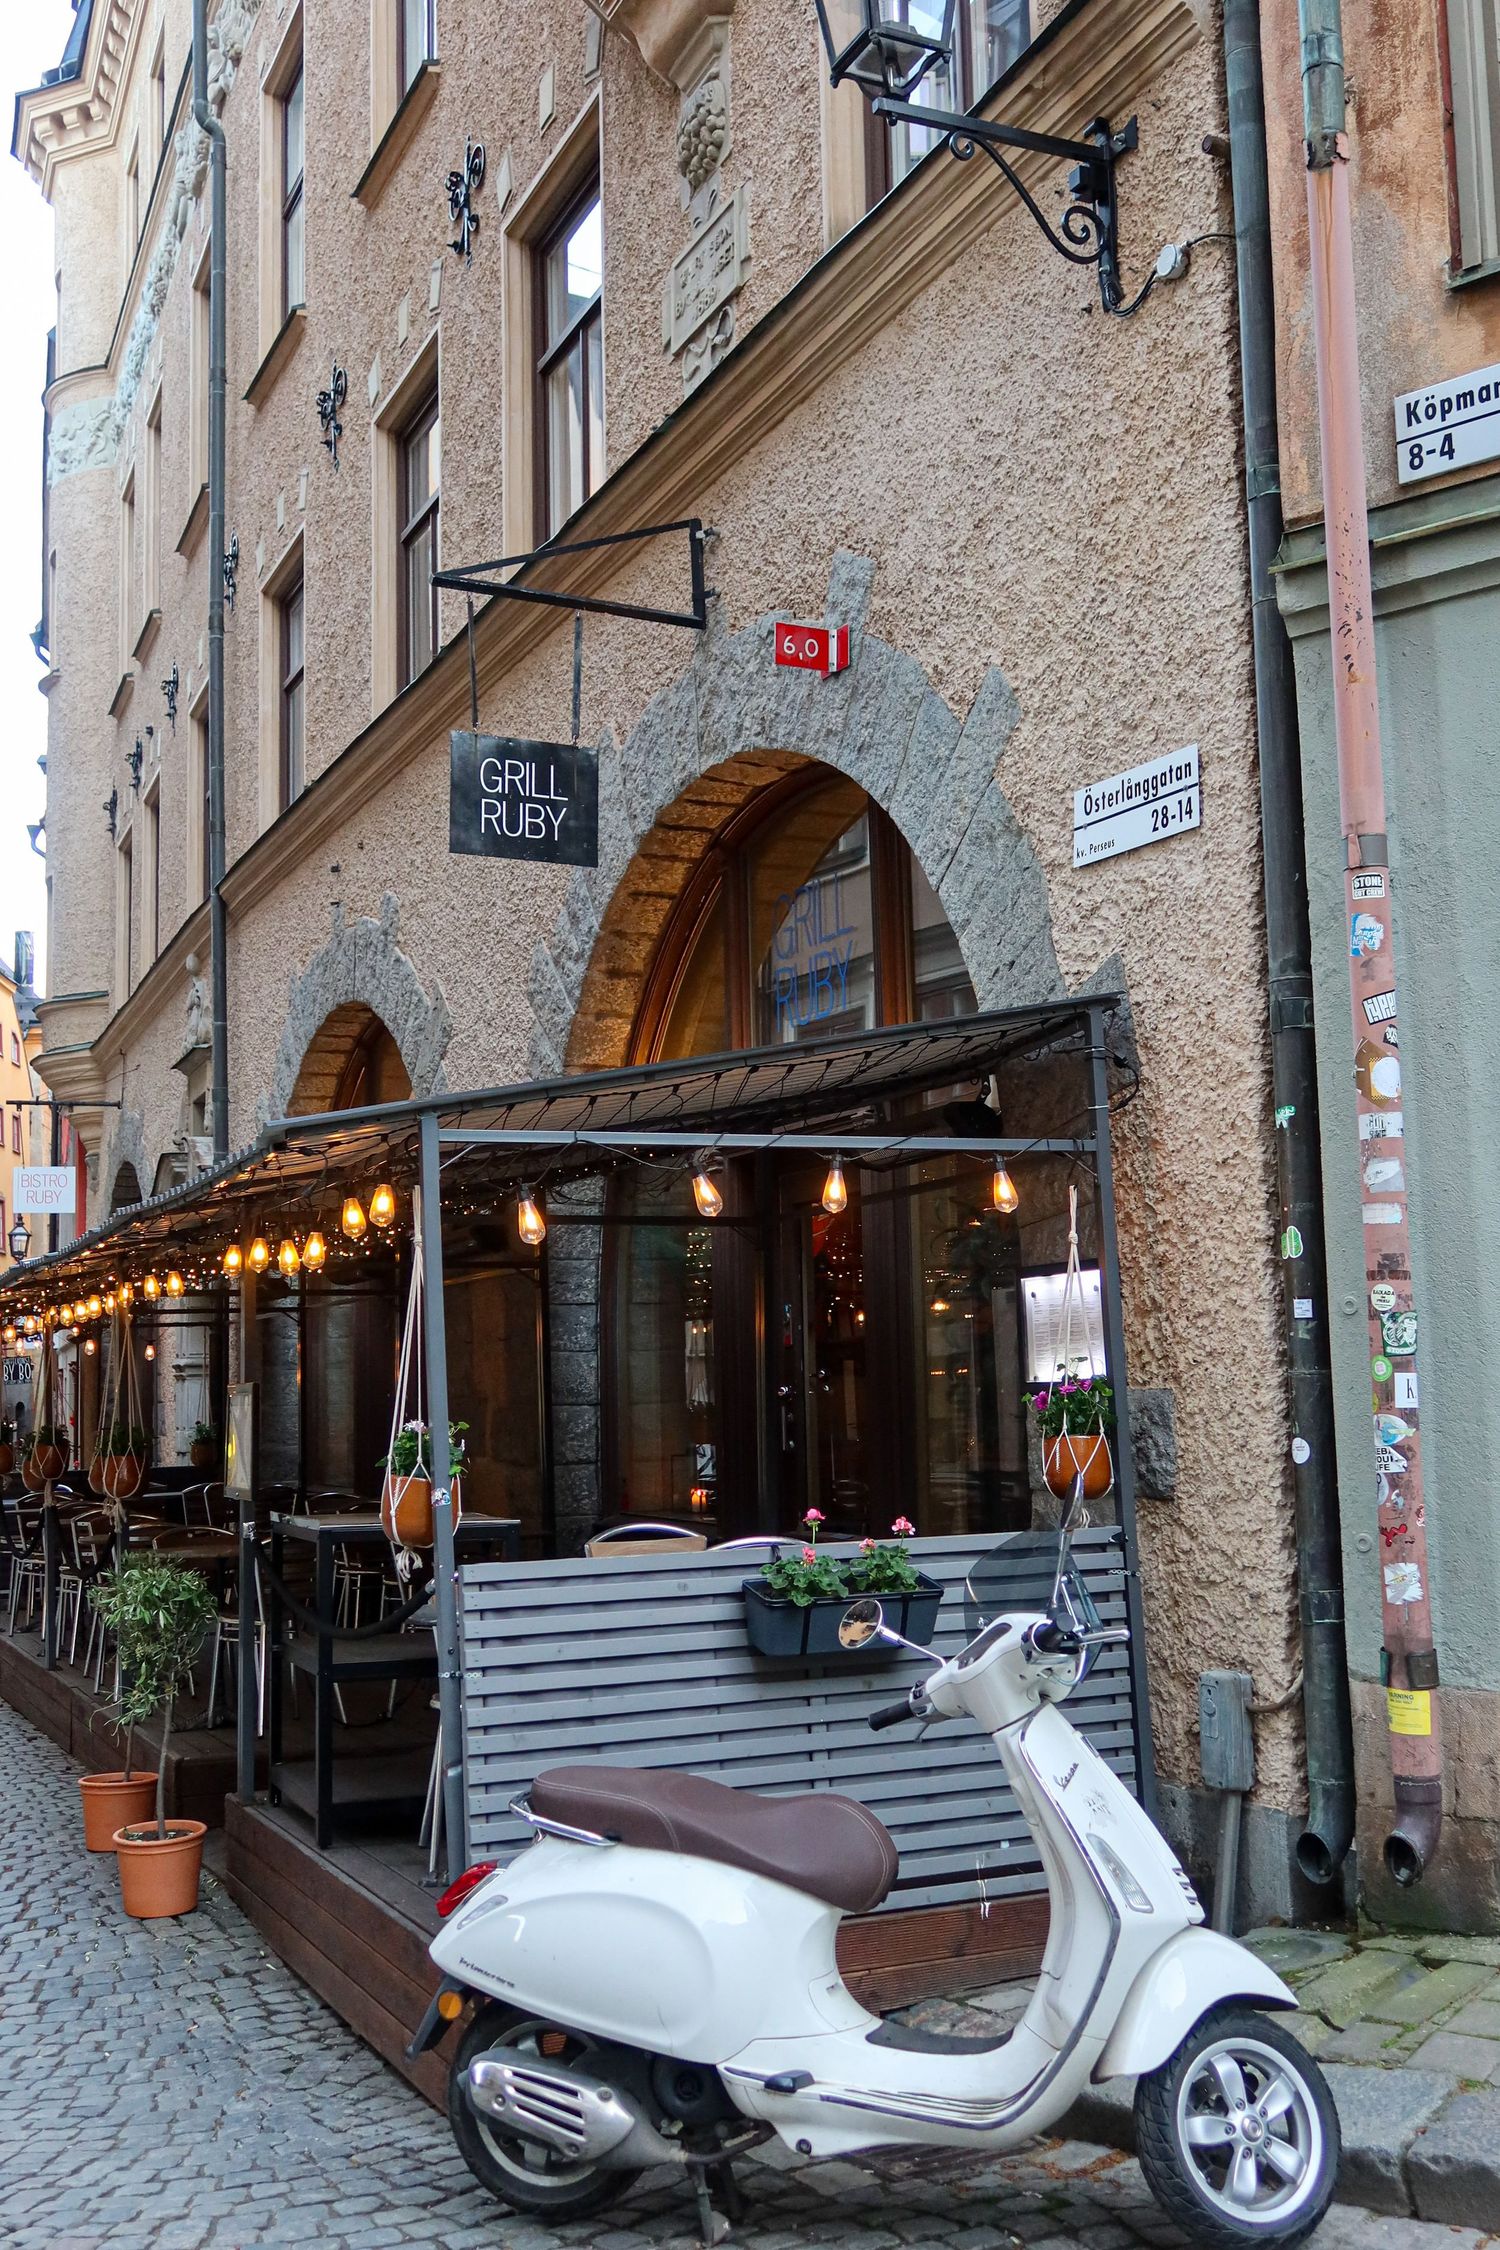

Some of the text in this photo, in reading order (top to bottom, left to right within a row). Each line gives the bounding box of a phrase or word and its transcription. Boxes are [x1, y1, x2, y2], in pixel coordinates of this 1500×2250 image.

[1409, 432, 1455, 470] 8-4
[480, 757, 568, 801] GRILL
[1084, 761, 1192, 816] Österlånggatan
[481, 798, 567, 841] RUBY
[1151, 796, 1193, 833] 28-14
[1076, 838, 1115, 859] kv. Perseus
[1354, 875, 1382, 888] STONE
[773, 872, 857, 960] GRILL
[773, 940, 854, 1033] RUBY
[21, 1173, 68, 1188] BISTRO
[26, 1190, 63, 1204] RUBY
[1052, 1762, 1080, 1792] Vespa
